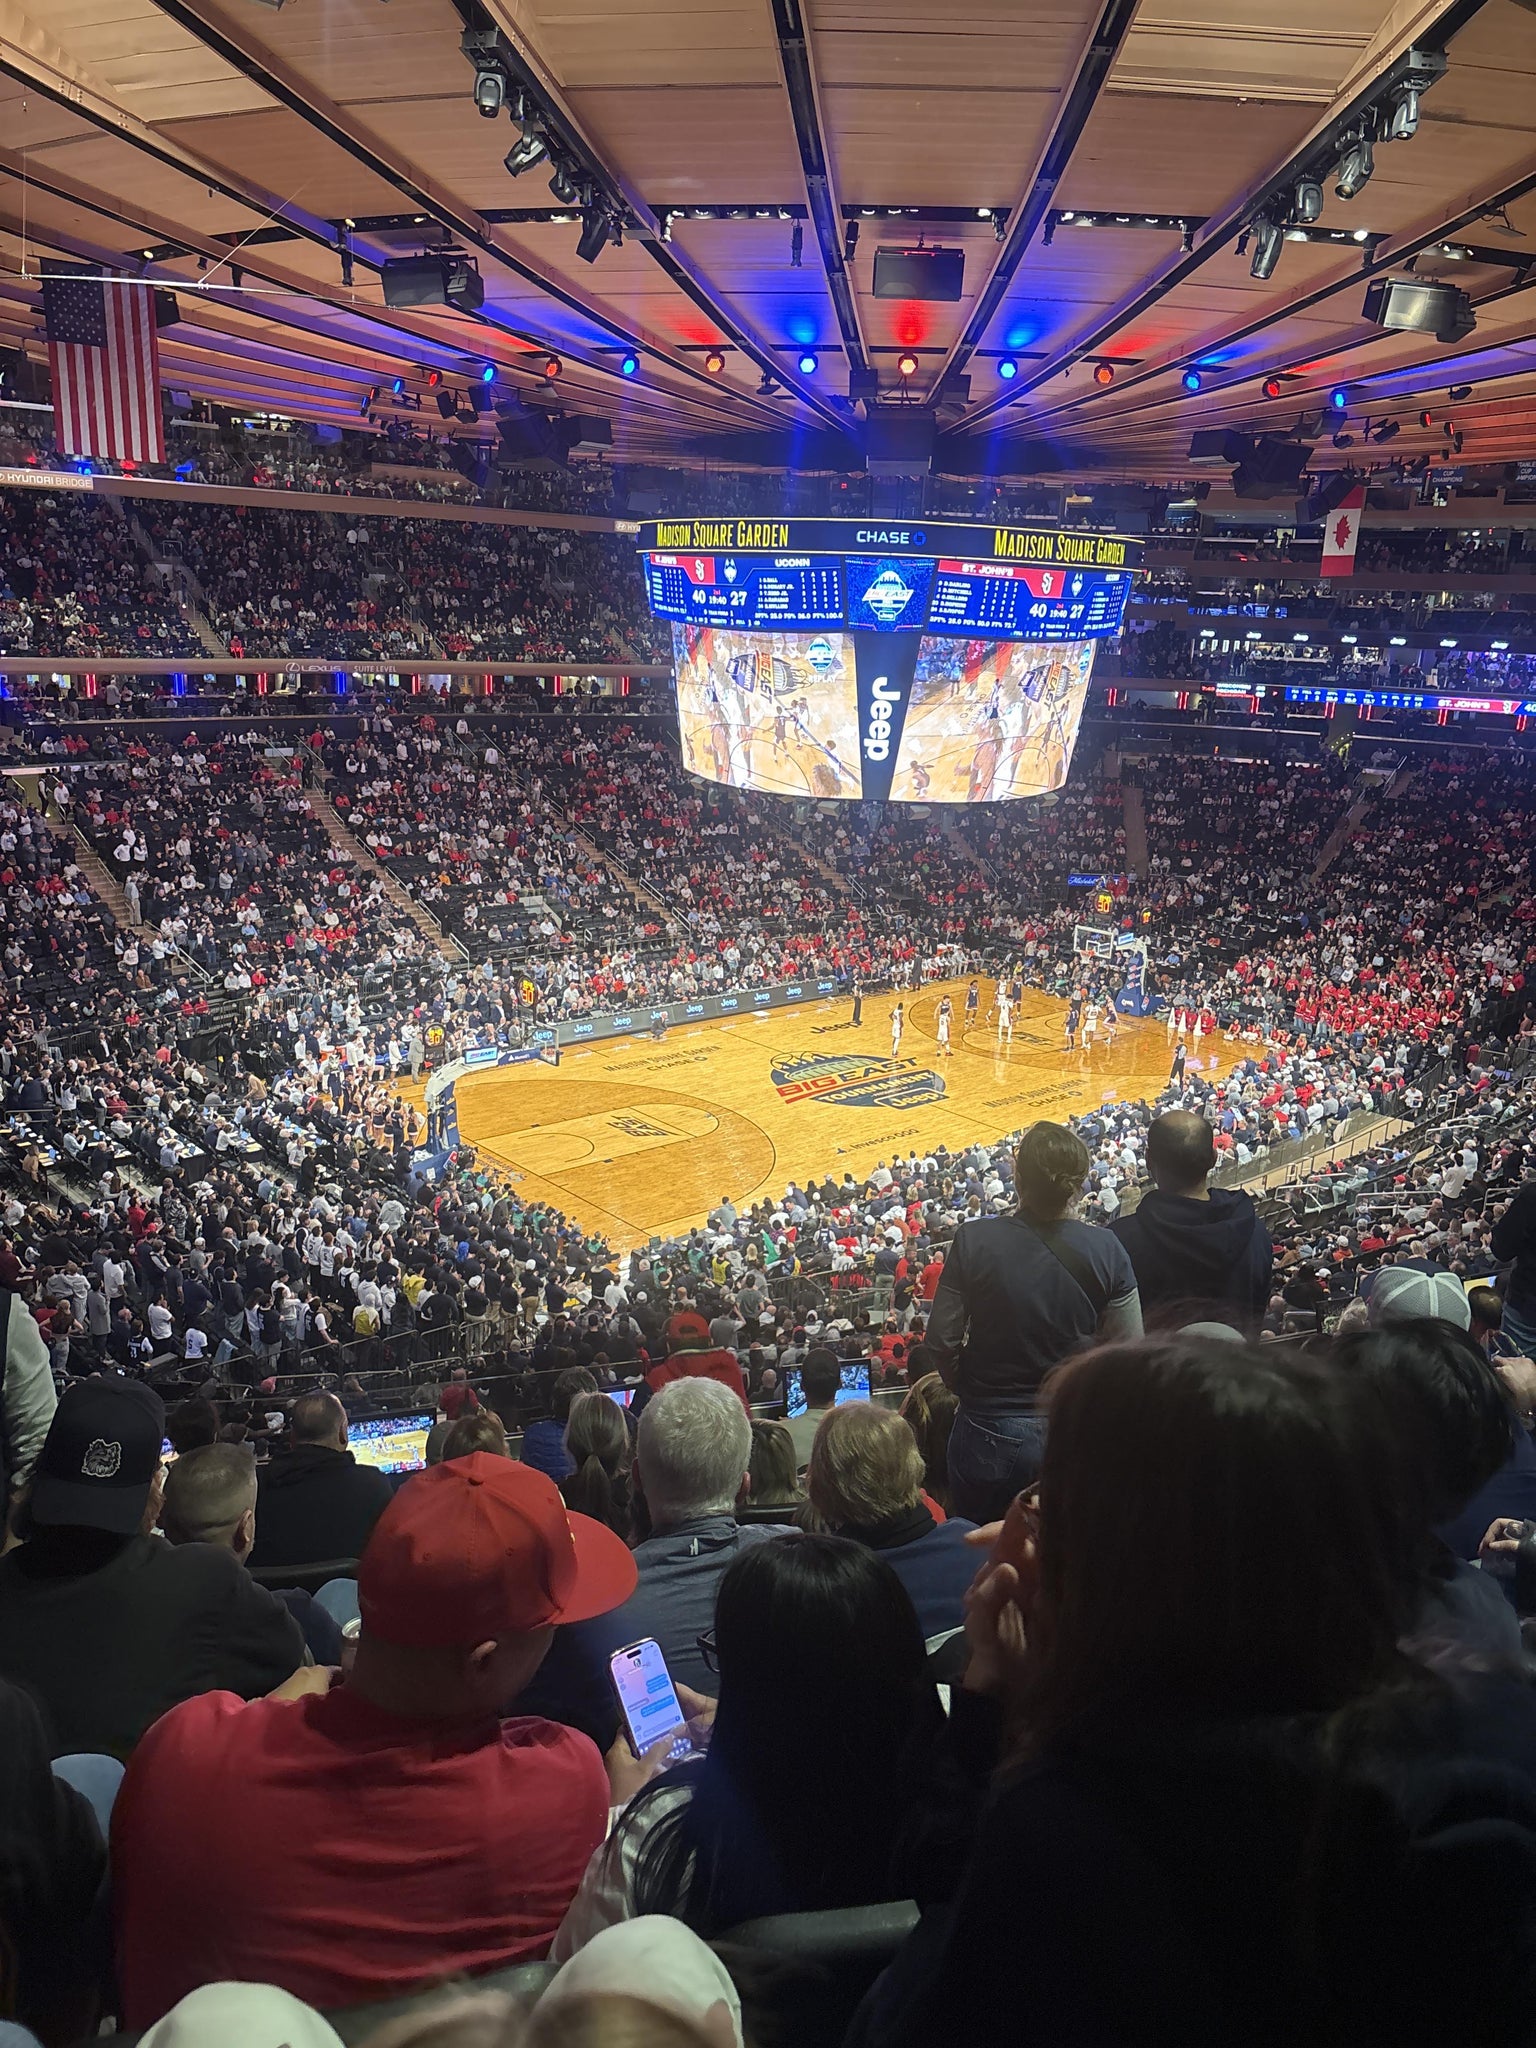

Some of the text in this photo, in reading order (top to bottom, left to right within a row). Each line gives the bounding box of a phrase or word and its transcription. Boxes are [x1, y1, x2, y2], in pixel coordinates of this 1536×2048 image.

[7, 473, 93, 487] HYUNDAI BRIDGE
[657, 520, 789, 549] MADISON SQUARE GARDEN
[856, 530, 911, 545] CHASE
[993, 529, 1126, 565] MADISON SQUARE GARDEN
[774, 558, 811, 567] UCONN
[961, 563, 1014, 577] ST. JOHN'S
[692, 589, 747, 606] 40 27
[709, 595, 727, 605] 19:40
[1029, 603, 1085, 619] 40 27
[1049, 609, 1068, 619] 19:40
[354, 665, 374, 673] SUITE
[376, 665, 397, 673] LEVEL
[760, 668, 772, 704] EAST
[1044, 676, 1057, 711] EAST
[1437, 699, 1490, 710] ST. JOHN'S
[863, 676, 901, 761] Jeep
[1097, 901, 1110, 913] 30
[786, 986, 802, 996] Jeep
[817, 981, 833, 991] Jeep
[522, 988, 534, 1004] 30
[720, 998, 737, 1008] Jeep
[754, 992, 770, 1002] Jeep
[686, 1004, 704, 1014] Jeep
[573, 1023, 593, 1033] Jeep
[613, 1016, 632, 1027] Jeep
[532, 1030, 553, 1042] Jeep
[602, 1045, 723, 1072] MADISON SQUARE GARDEN
[646, 1058, 696, 1072] CHASE
[776, 1057, 918, 1097] BIG EAST
[818, 1070, 936, 1103] TOURNAMENT
[891, 1091, 939, 1107] Jeep
[981, 1092, 1027, 1108] MADISON
[1025, 1083, 1061, 1098] SQUARE
[1028, 1093, 1072, 1108] CHASE
[849, 1134, 896, 1150] Invesco
